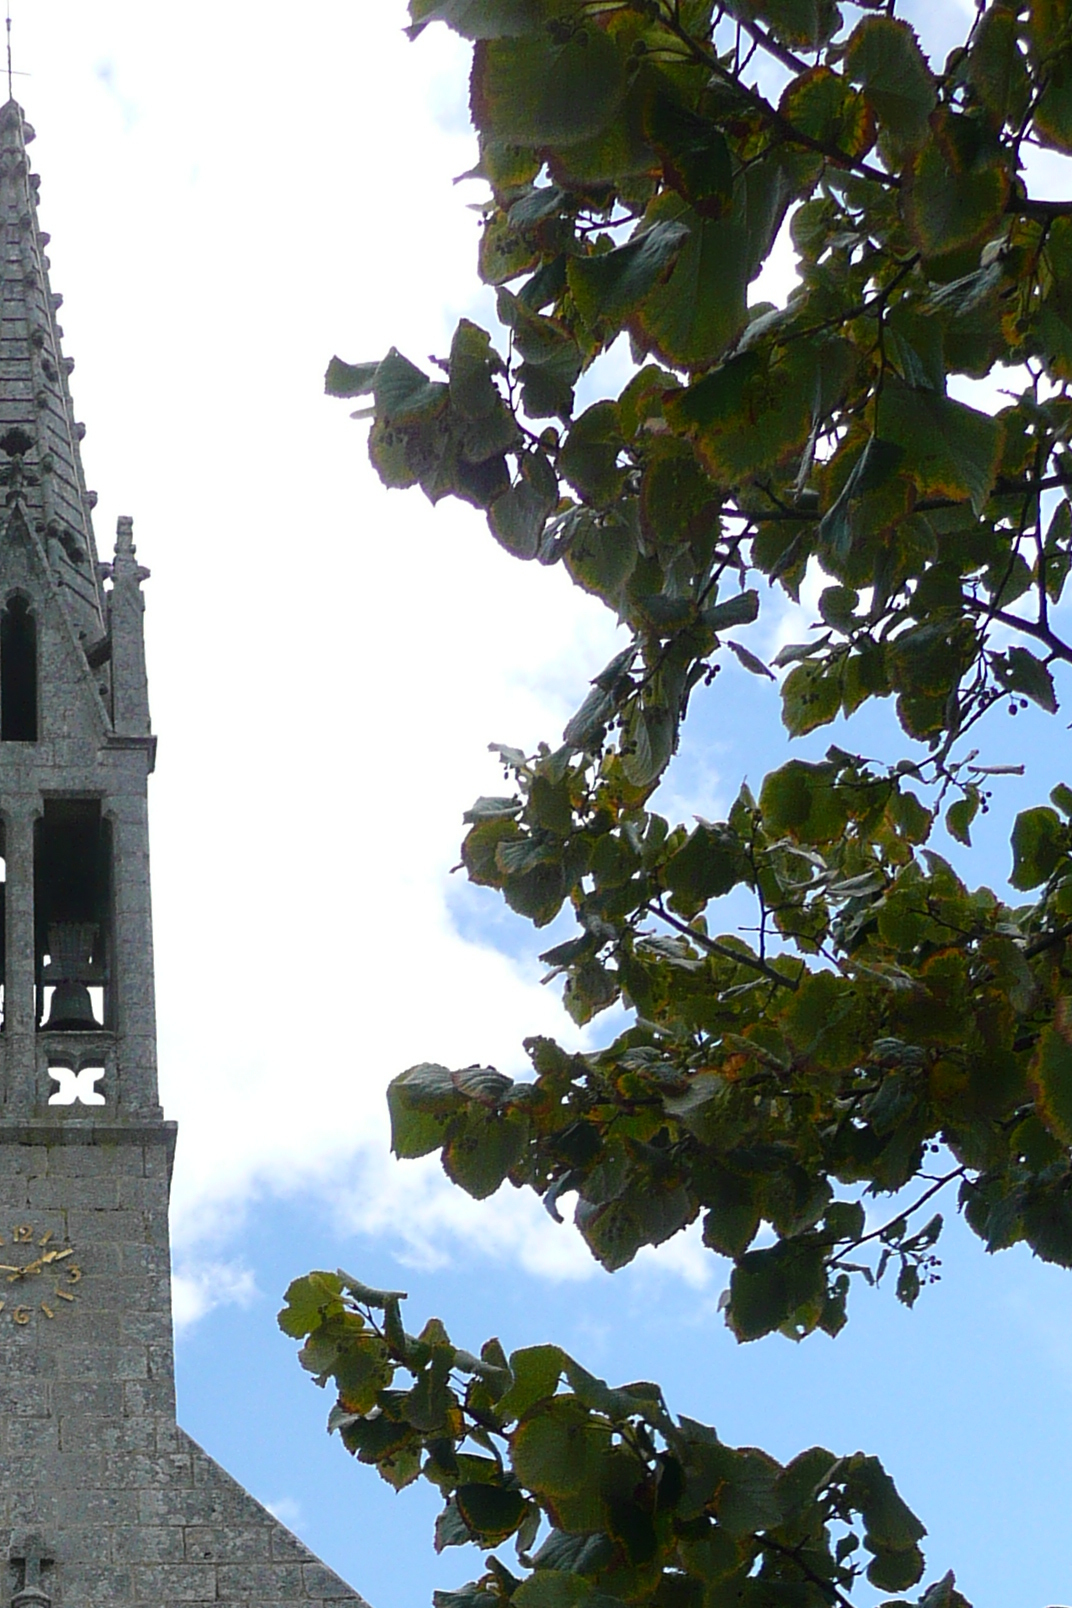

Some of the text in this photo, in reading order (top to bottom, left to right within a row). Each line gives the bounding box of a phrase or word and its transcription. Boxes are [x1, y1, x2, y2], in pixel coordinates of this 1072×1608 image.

[14, 1225, 33, 1243] 12
[67, 1263, 82, 1284] 3
[13, 1303, 32, 1324] 6
